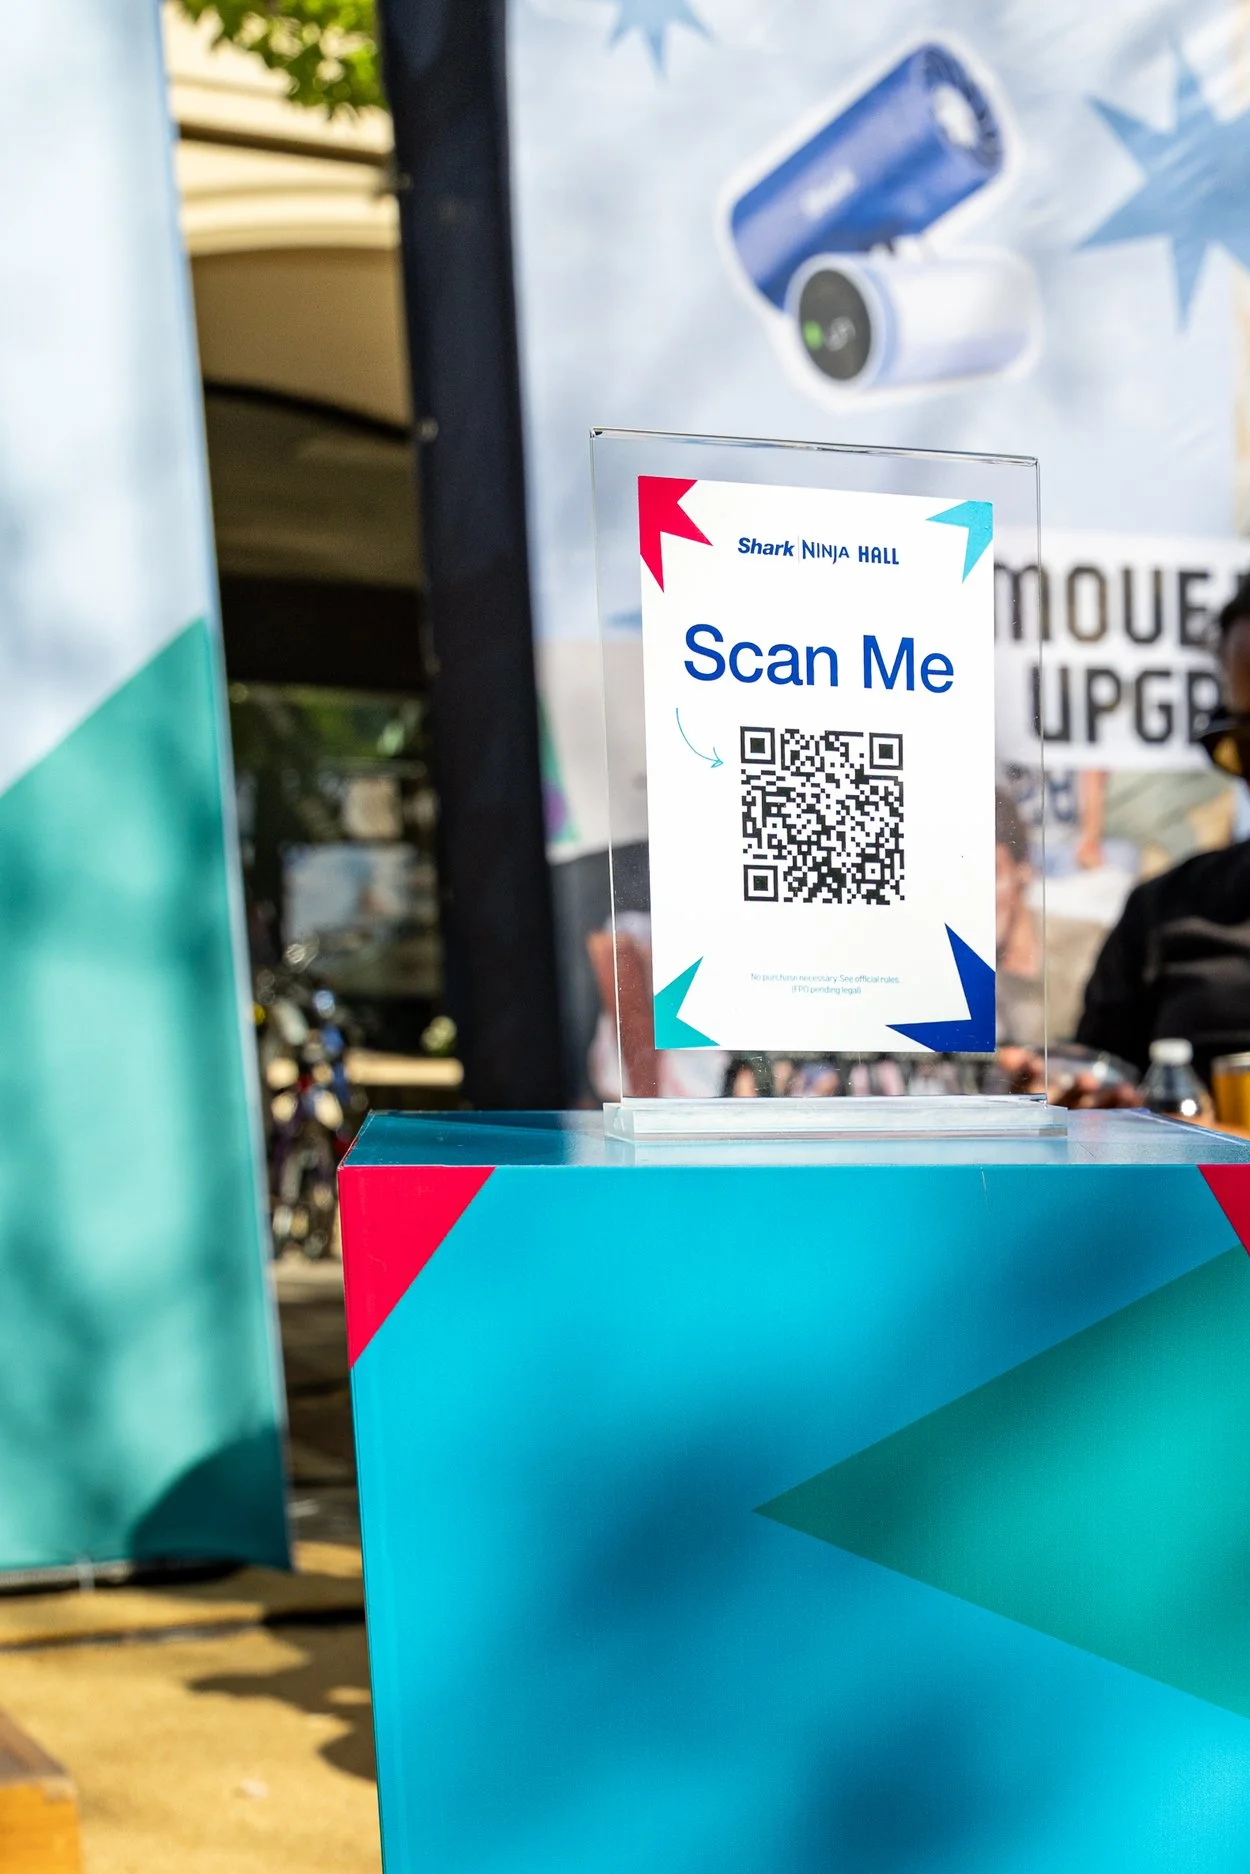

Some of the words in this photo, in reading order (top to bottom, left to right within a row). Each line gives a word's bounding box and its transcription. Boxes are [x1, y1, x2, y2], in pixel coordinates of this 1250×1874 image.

[737, 537, 795, 557] Shark
[801, 539, 850, 565] NINJA
[858, 545, 899, 565] HALL
[684, 623, 839, 687] Scan
[863, 634, 954, 693] Me
[1030, 665, 1222, 745] UPGR
[751, 972, 761, 981] No
[762, 973, 798, 983] purchase
[839, 974, 853, 983] See
[854, 974, 880, 984] official
[810, 986, 840, 995] pending
[841, 986, 862, 995] legal)
